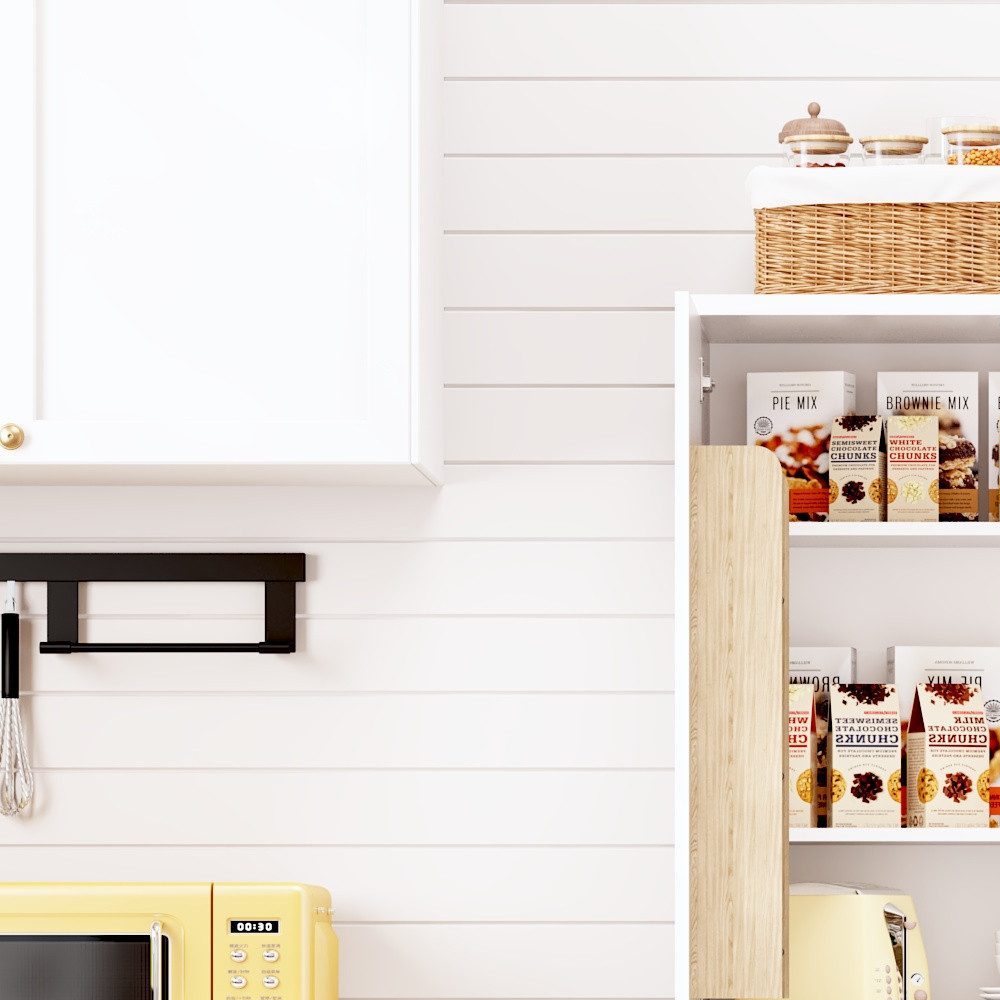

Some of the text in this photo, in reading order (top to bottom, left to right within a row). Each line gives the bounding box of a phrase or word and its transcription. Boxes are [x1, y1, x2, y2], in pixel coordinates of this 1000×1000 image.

[773, 396, 817, 410] PIE MIX
[887, 396, 969, 410] BROWNIE MIX
[831, 452, 876, 460] CHUNKS
[890, 452, 936, 460] CHUNKS
[237, 922, 272, 932] 00:30
